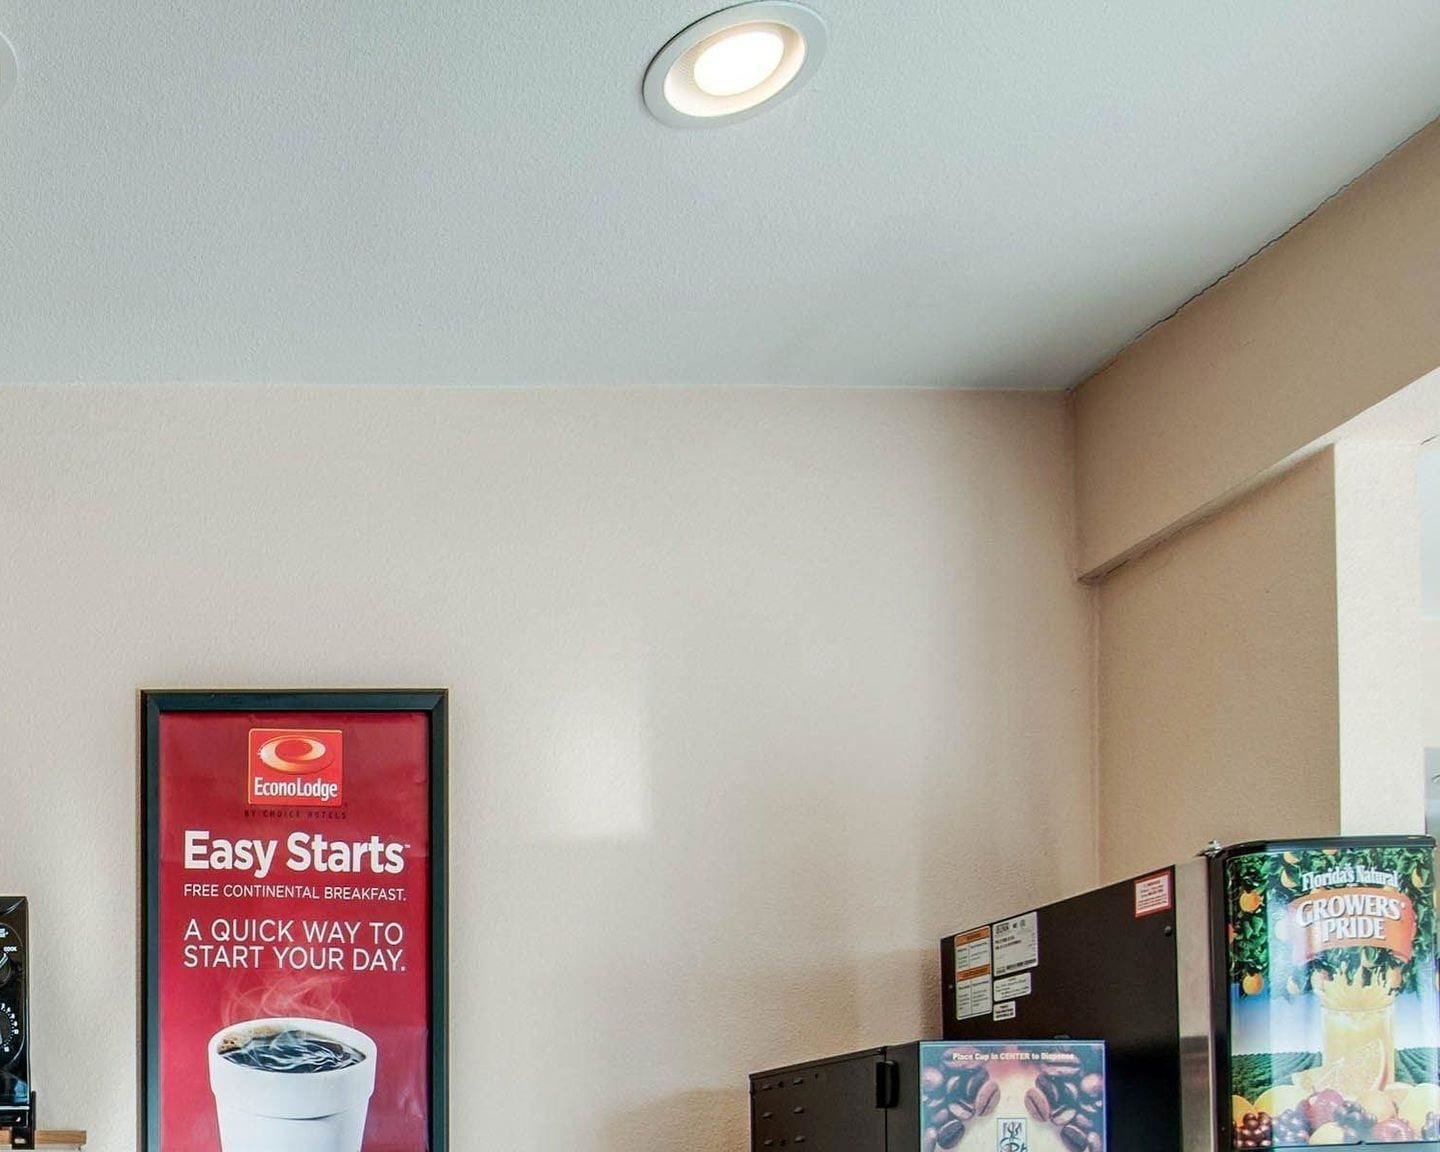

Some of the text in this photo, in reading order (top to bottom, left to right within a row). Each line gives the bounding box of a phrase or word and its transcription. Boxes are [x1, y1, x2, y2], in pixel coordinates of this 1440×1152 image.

[254, 776, 338, 802] EconoLodge
[244, 809, 257, 818] BY
[263, 809, 300, 818] CHOICE
[183, 830, 405, 879] Easy Starts
[1301, 863, 1400, 892] Florida's Natural
[183, 883, 407, 901] FREE CONTINENTAL BREAKFAST.
[183, 918, 404, 945] A QUICK WAY TO
[1320, 917, 1387, 943] PRIDE
[183, 945, 407, 972] START YOUR DAY.
[952, 1052, 973, 1061] Place
[975, 1052, 989, 1062] Cup
[991, 1052, 999, 1060] in
[1000, 1052, 1031, 1060] CENTER
